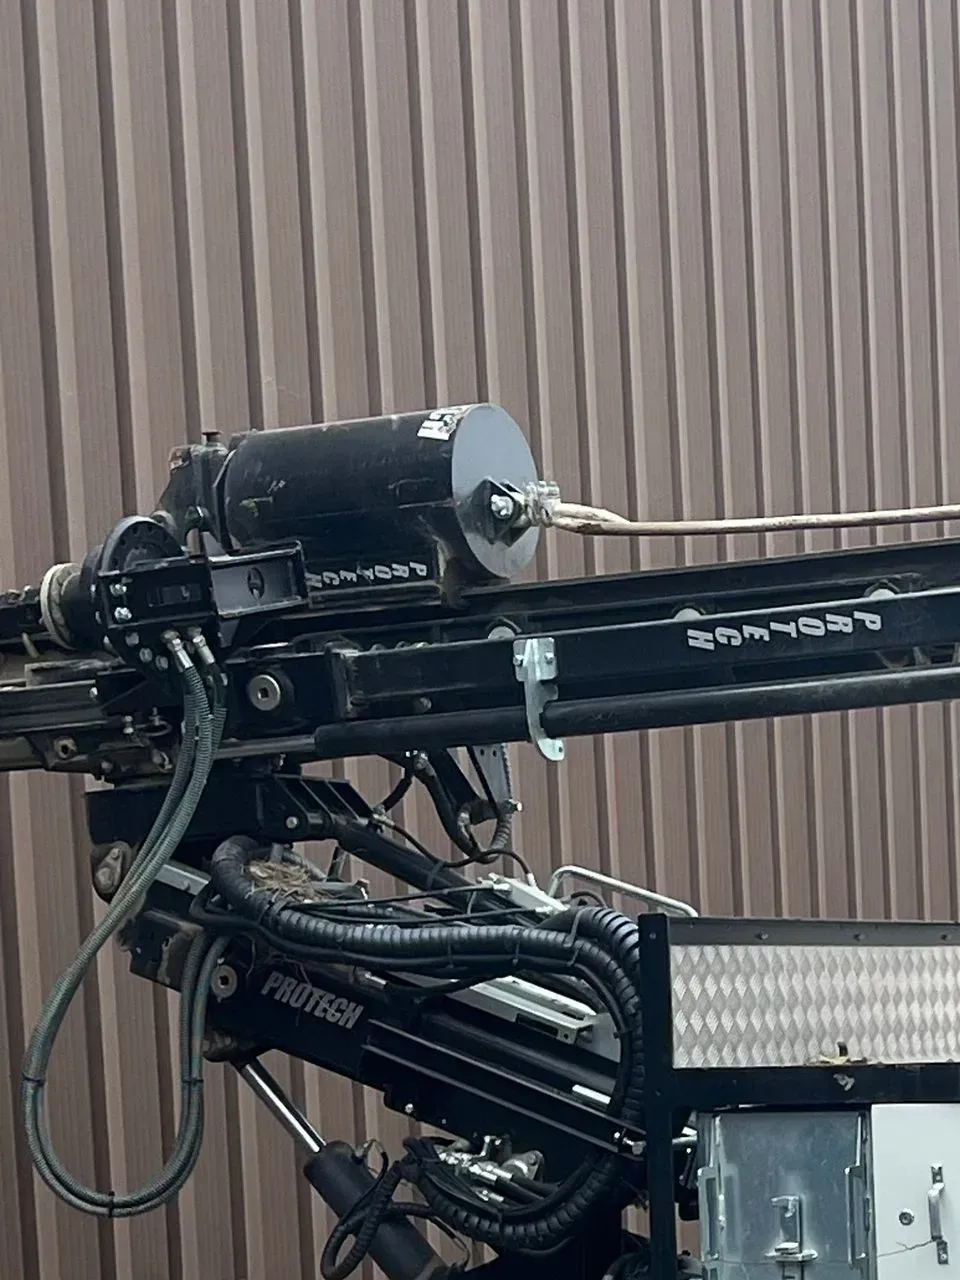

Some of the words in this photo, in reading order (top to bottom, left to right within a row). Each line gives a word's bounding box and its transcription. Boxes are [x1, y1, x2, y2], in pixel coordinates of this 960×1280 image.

[304, 562, 427, 588] PROTECH
[687, 610, 882, 650] PROTECH
[261, 970, 364, 1029] PROTECH
